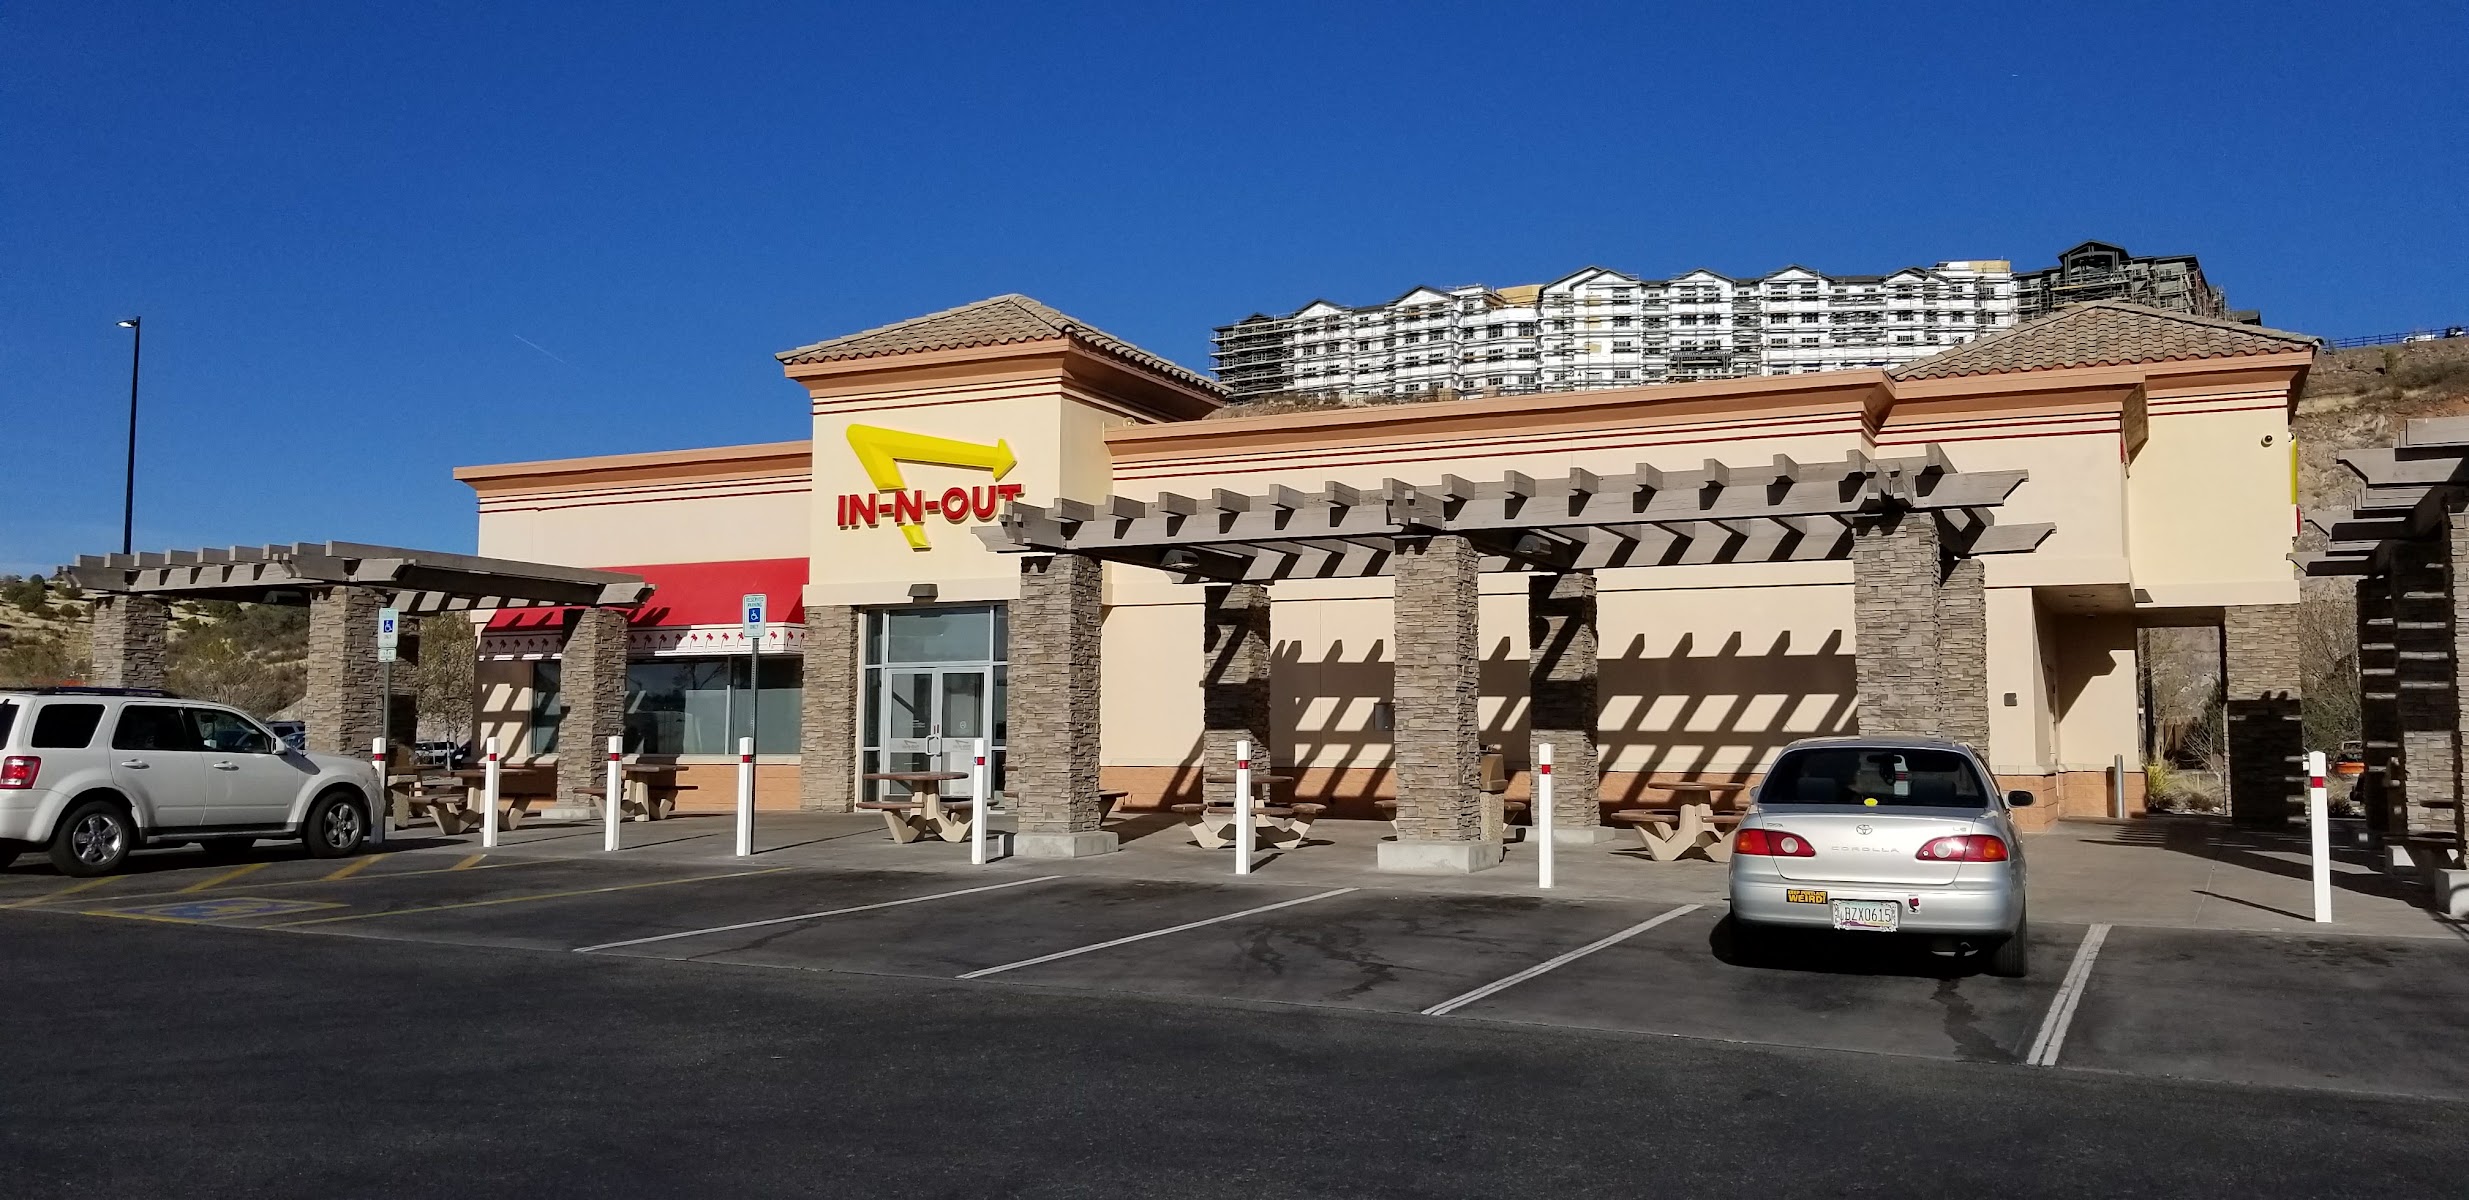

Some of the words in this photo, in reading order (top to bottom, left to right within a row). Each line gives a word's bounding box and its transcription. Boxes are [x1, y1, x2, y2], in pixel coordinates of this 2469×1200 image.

[838, 484, 1023, 529] IN-N-OUT
[1788, 894, 1826, 903] WEIRD!
[1844, 907, 1891, 922] BZX0615
